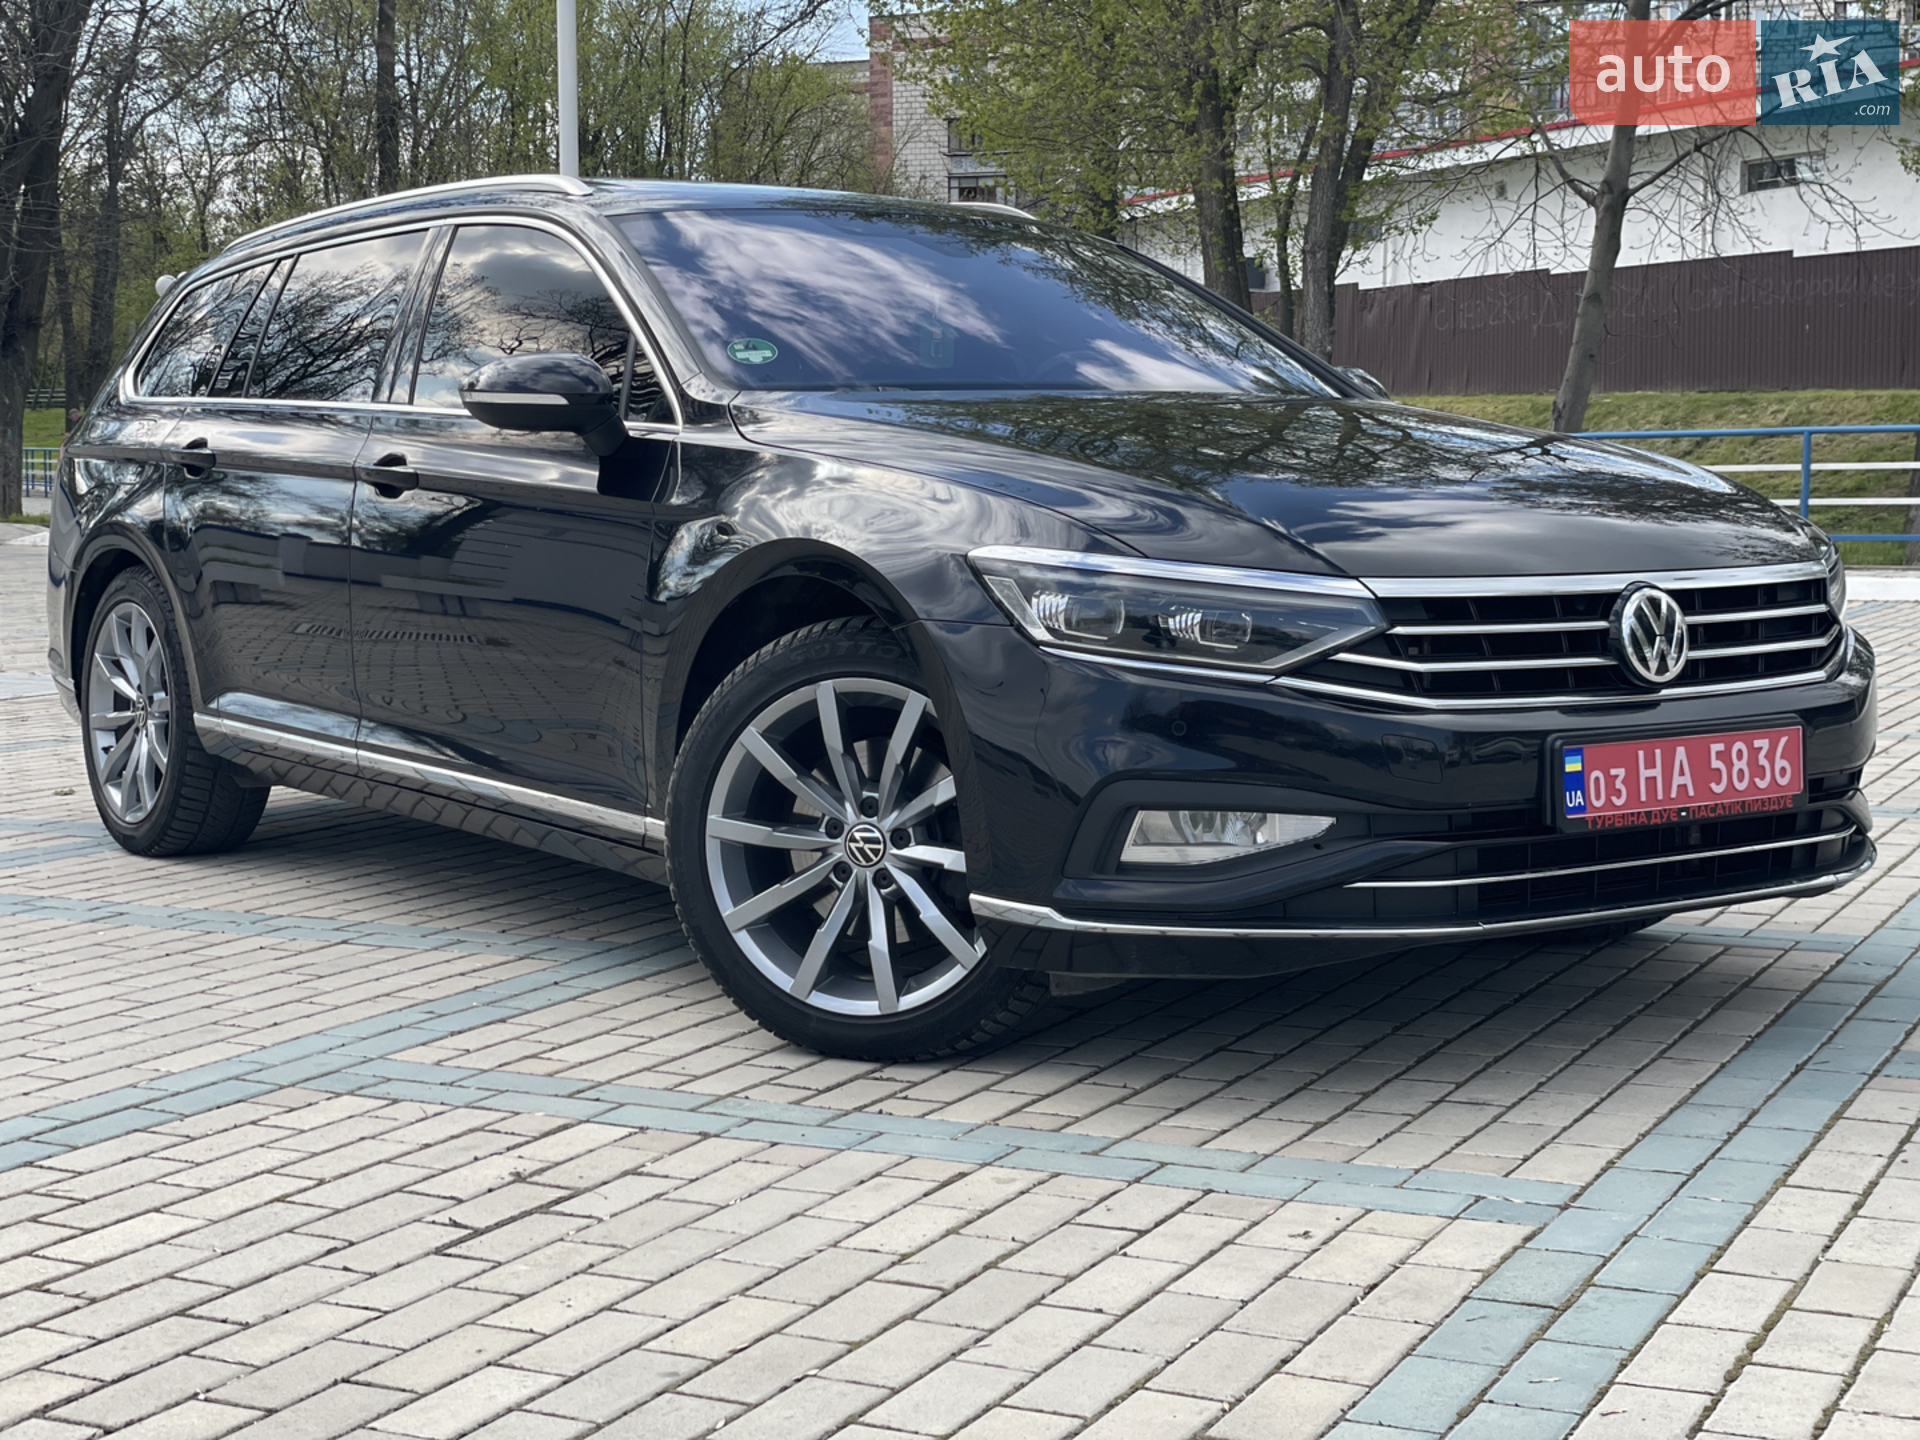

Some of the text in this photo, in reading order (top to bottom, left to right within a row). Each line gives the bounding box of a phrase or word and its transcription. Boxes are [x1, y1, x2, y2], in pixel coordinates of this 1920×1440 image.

[1589, 736, 1793, 808] 03 HA 5836
[1566, 791, 1585, 807] UA
[1585, 811, 1648, 829] ТУРБІНА
[1650, 808, 1679, 826] ДУЄ
[1689, 800, 1743, 819] ПАСАТІК
[1745, 794, 1794, 813] ПИЗДУЄ
